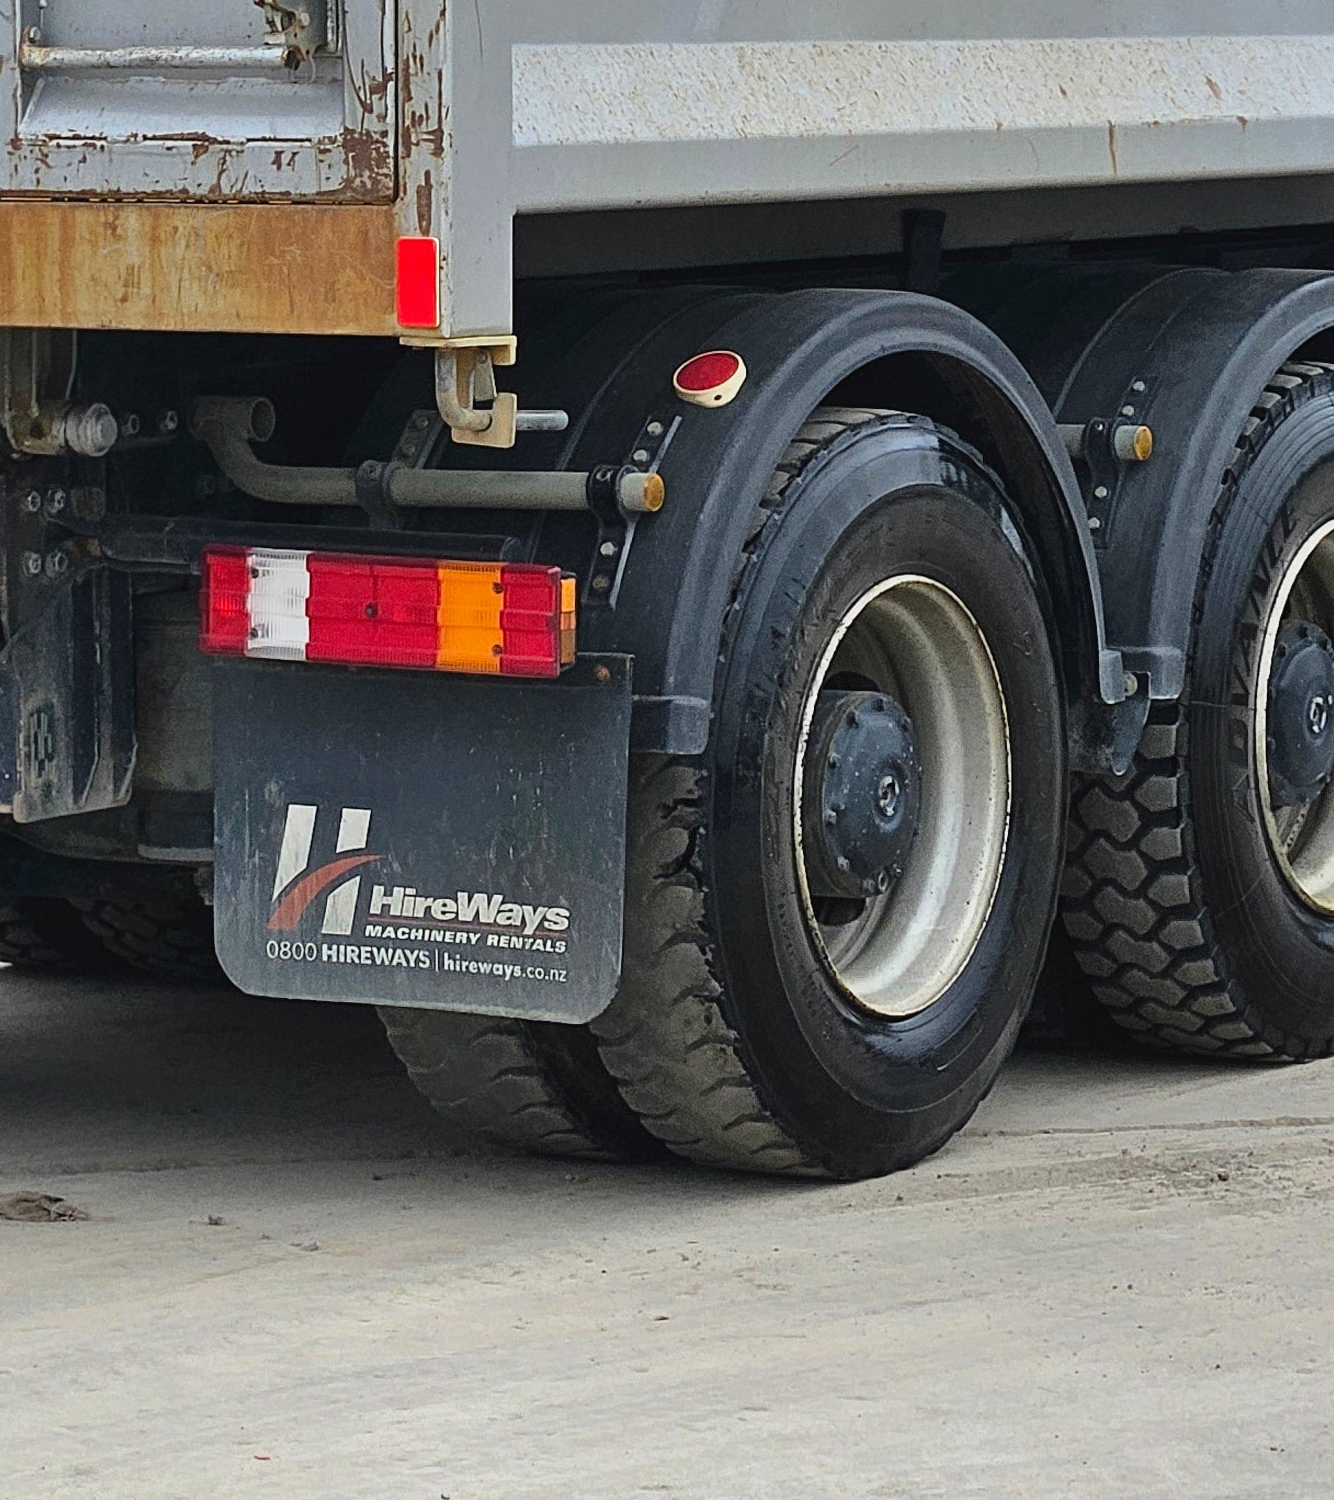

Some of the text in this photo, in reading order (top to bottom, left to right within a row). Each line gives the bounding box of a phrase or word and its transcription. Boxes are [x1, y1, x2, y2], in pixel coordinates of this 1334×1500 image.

[369, 884, 571, 936] HireWays
[365, 924, 567, 954] MACHINERY RENTALS
[266, 940, 567, 983] 0800 HIREWAYS hireways.co.nz
